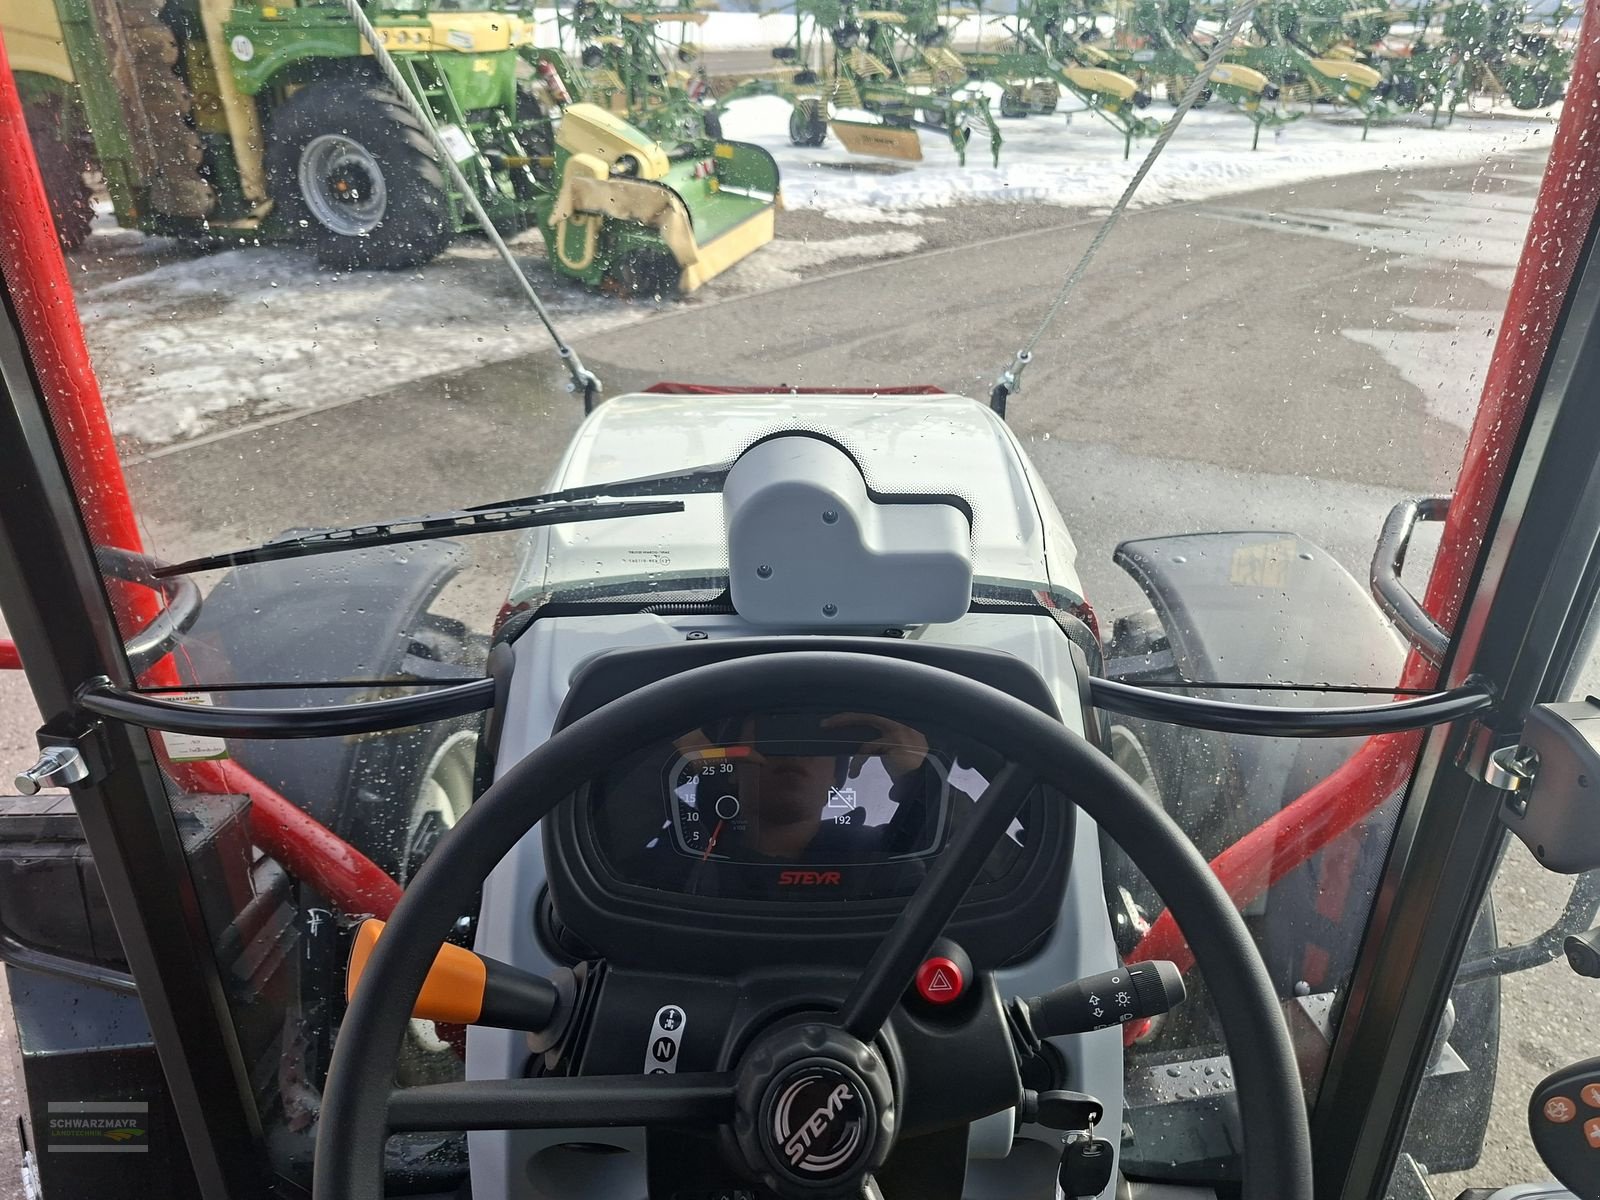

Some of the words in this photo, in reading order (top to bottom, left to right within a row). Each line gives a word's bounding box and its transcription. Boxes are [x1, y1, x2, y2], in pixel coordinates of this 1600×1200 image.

[702, 766, 716, 776] 25
[720, 763, 734, 773] 30
[686, 775, 700, 785] 20
[684, 793, 697, 803] 15
[686, 812, 700, 822] 10
[834, 815, 852, 825] 192
[693, 831, 700, 841] 5
[778, 871, 841, 885] STEYR
[656, 1041, 672, 1058] N
[785, 1083, 854, 1166] STEYR
